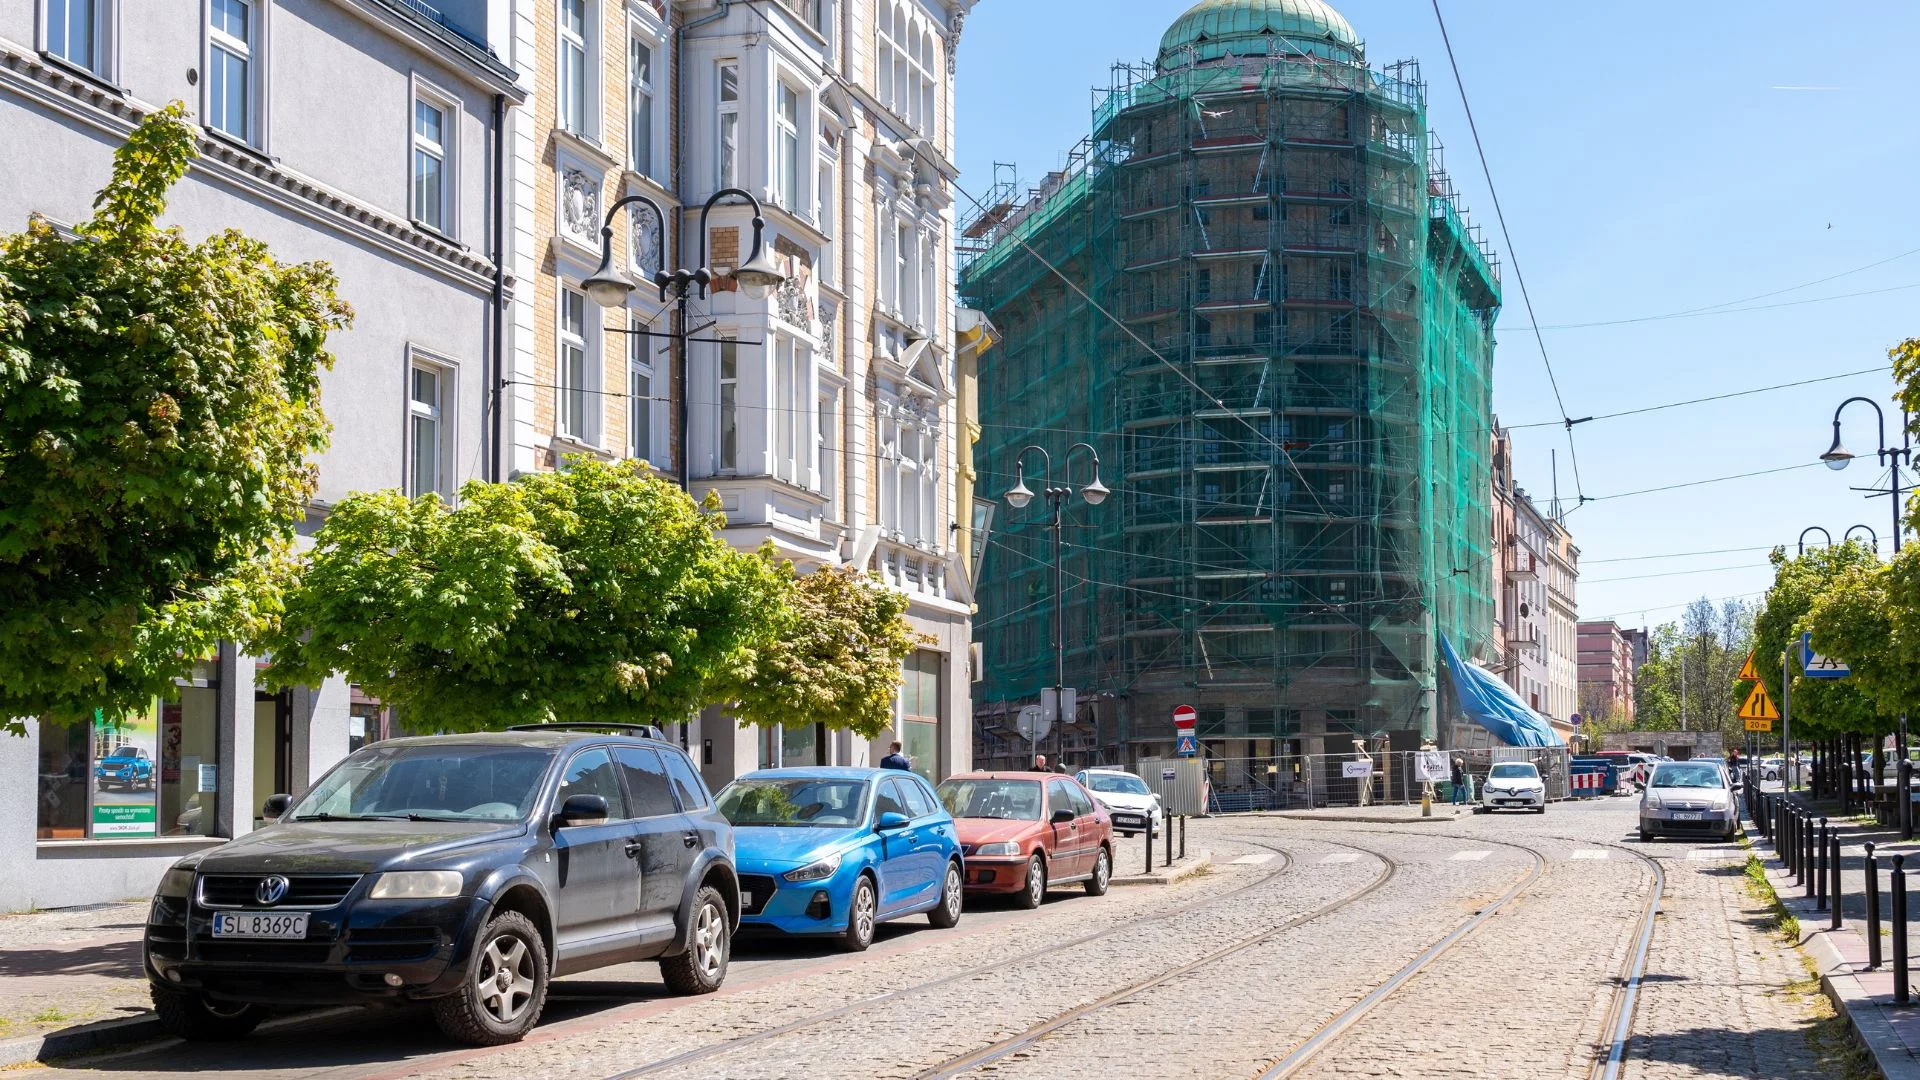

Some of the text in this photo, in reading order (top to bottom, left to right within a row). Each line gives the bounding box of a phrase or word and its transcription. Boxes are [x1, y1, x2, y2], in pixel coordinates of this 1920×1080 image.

[1750, 721, 1760, 729] 20
[224, 916, 303, 935] SL 8369C
